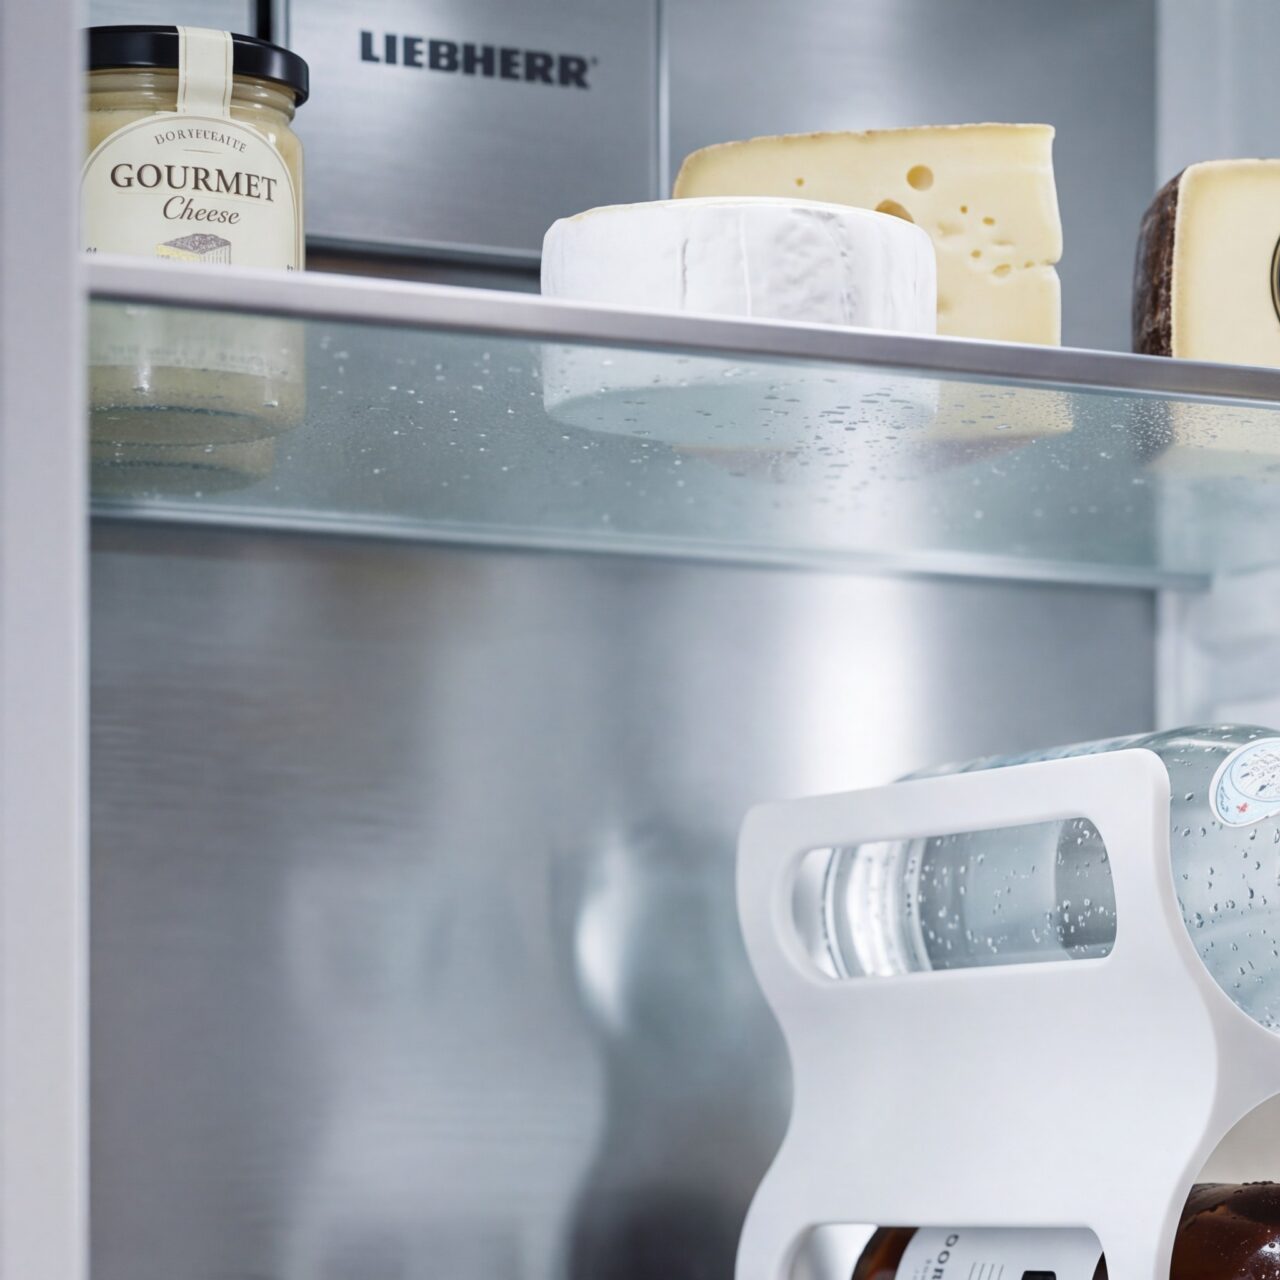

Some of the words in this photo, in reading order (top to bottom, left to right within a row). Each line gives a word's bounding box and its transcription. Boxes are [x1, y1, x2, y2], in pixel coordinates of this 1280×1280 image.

[360, 31, 590, 90] LIEBHERR
[110, 163, 278, 202] GOURMET
[162, 195, 241, 225] Cheese
